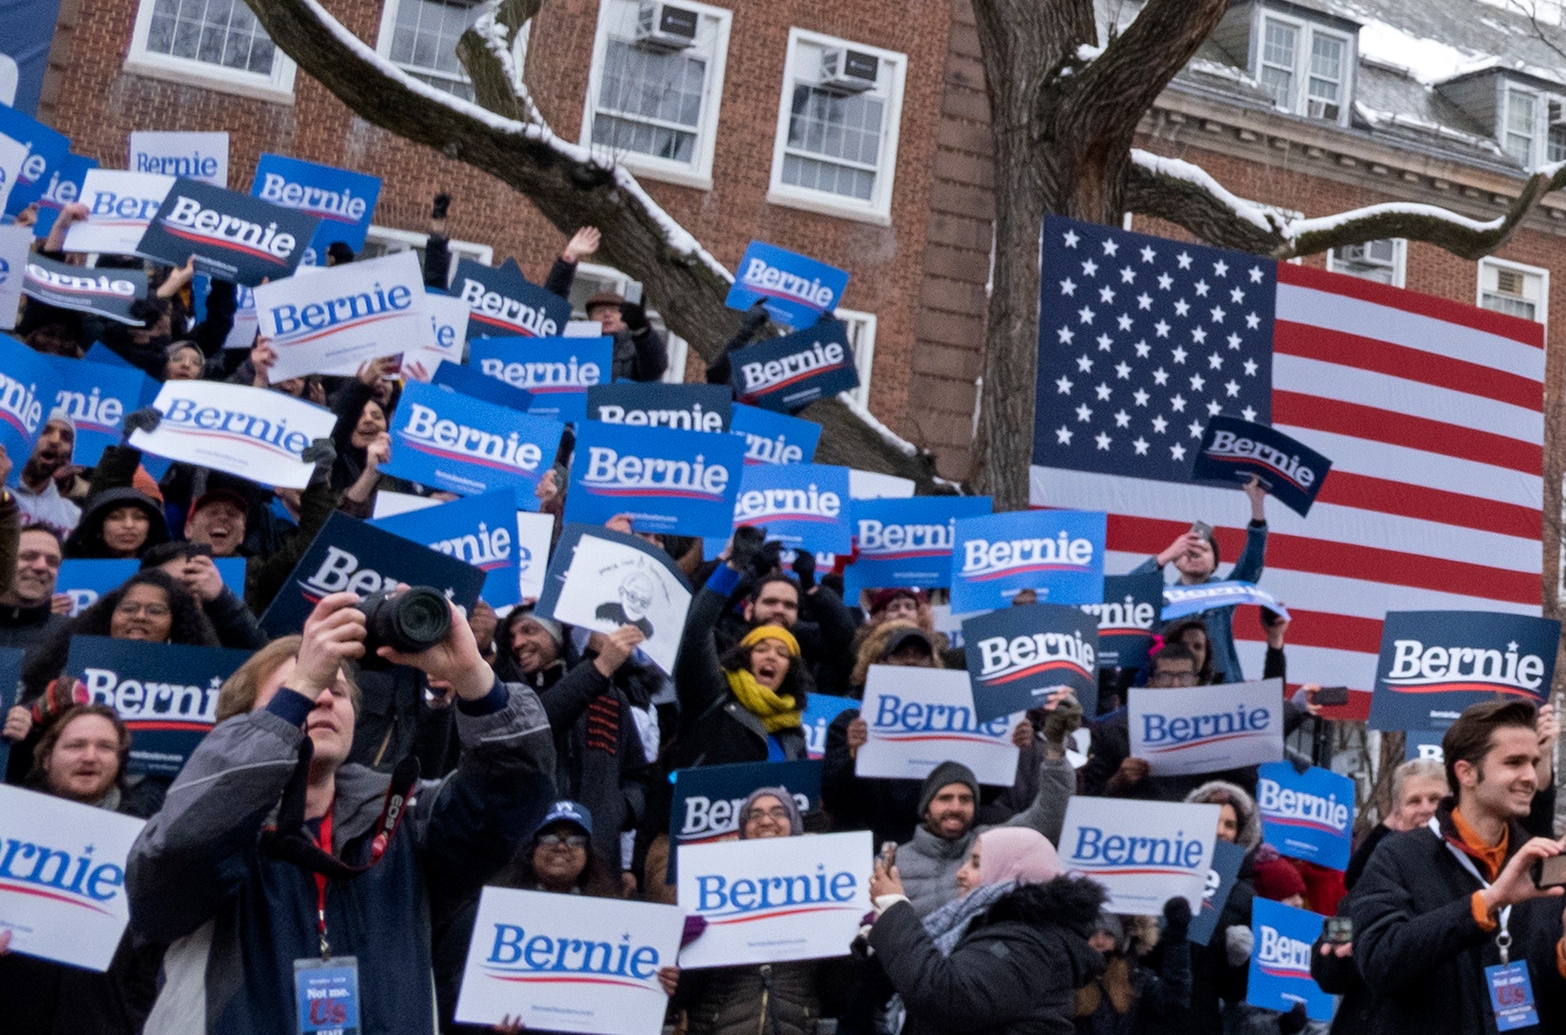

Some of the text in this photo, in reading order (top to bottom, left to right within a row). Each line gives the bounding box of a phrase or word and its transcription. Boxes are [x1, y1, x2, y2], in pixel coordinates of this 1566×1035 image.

[137, 151, 217, 177] Bernie
[91, 191, 161, 220] Ber
[260, 172, 367, 220] Bernie
[168, 196, 296, 258] Bernie
[744, 257, 834, 307] Bernie
[270, 281, 412, 335] Bernie
[460, 277, 558, 338] Bernie
[742, 340, 844, 388] Bernie
[52, 386, 124, 427] nie
[163, 398, 310, 454] Bernie
[403, 402, 543, 470] Bernie
[744, 433, 803, 465] nie
[1209, 429, 1315, 487] Bernie
[584, 446, 729, 494] Bernie
[735, 483, 841, 517] ernie
[427, 521, 511, 561] rnie
[857, 516, 956, 550] Berni
[962, 529, 1094, 573] Bernie
[1081, 595, 1155, 629] nie
[978, 630, 1095, 674] Bernie
[1389, 639, 1545, 690] Bernie
[84, 667, 223, 723] Berni
[873, 694, 1010, 737] Berne
[1142, 704, 1270, 743] Bernie
[1258, 778, 1349, 831] Bernie
[0, 837, 125, 902] rnie
[1072, 826, 1204, 870] Bernie
[695, 862, 857, 912] Bernie
[486, 922, 660, 980] Bernie
[1257, 925, 1312, 972] Bern
[307, 988, 327, 1000] Not
[309, 998, 346, 1026] Us
